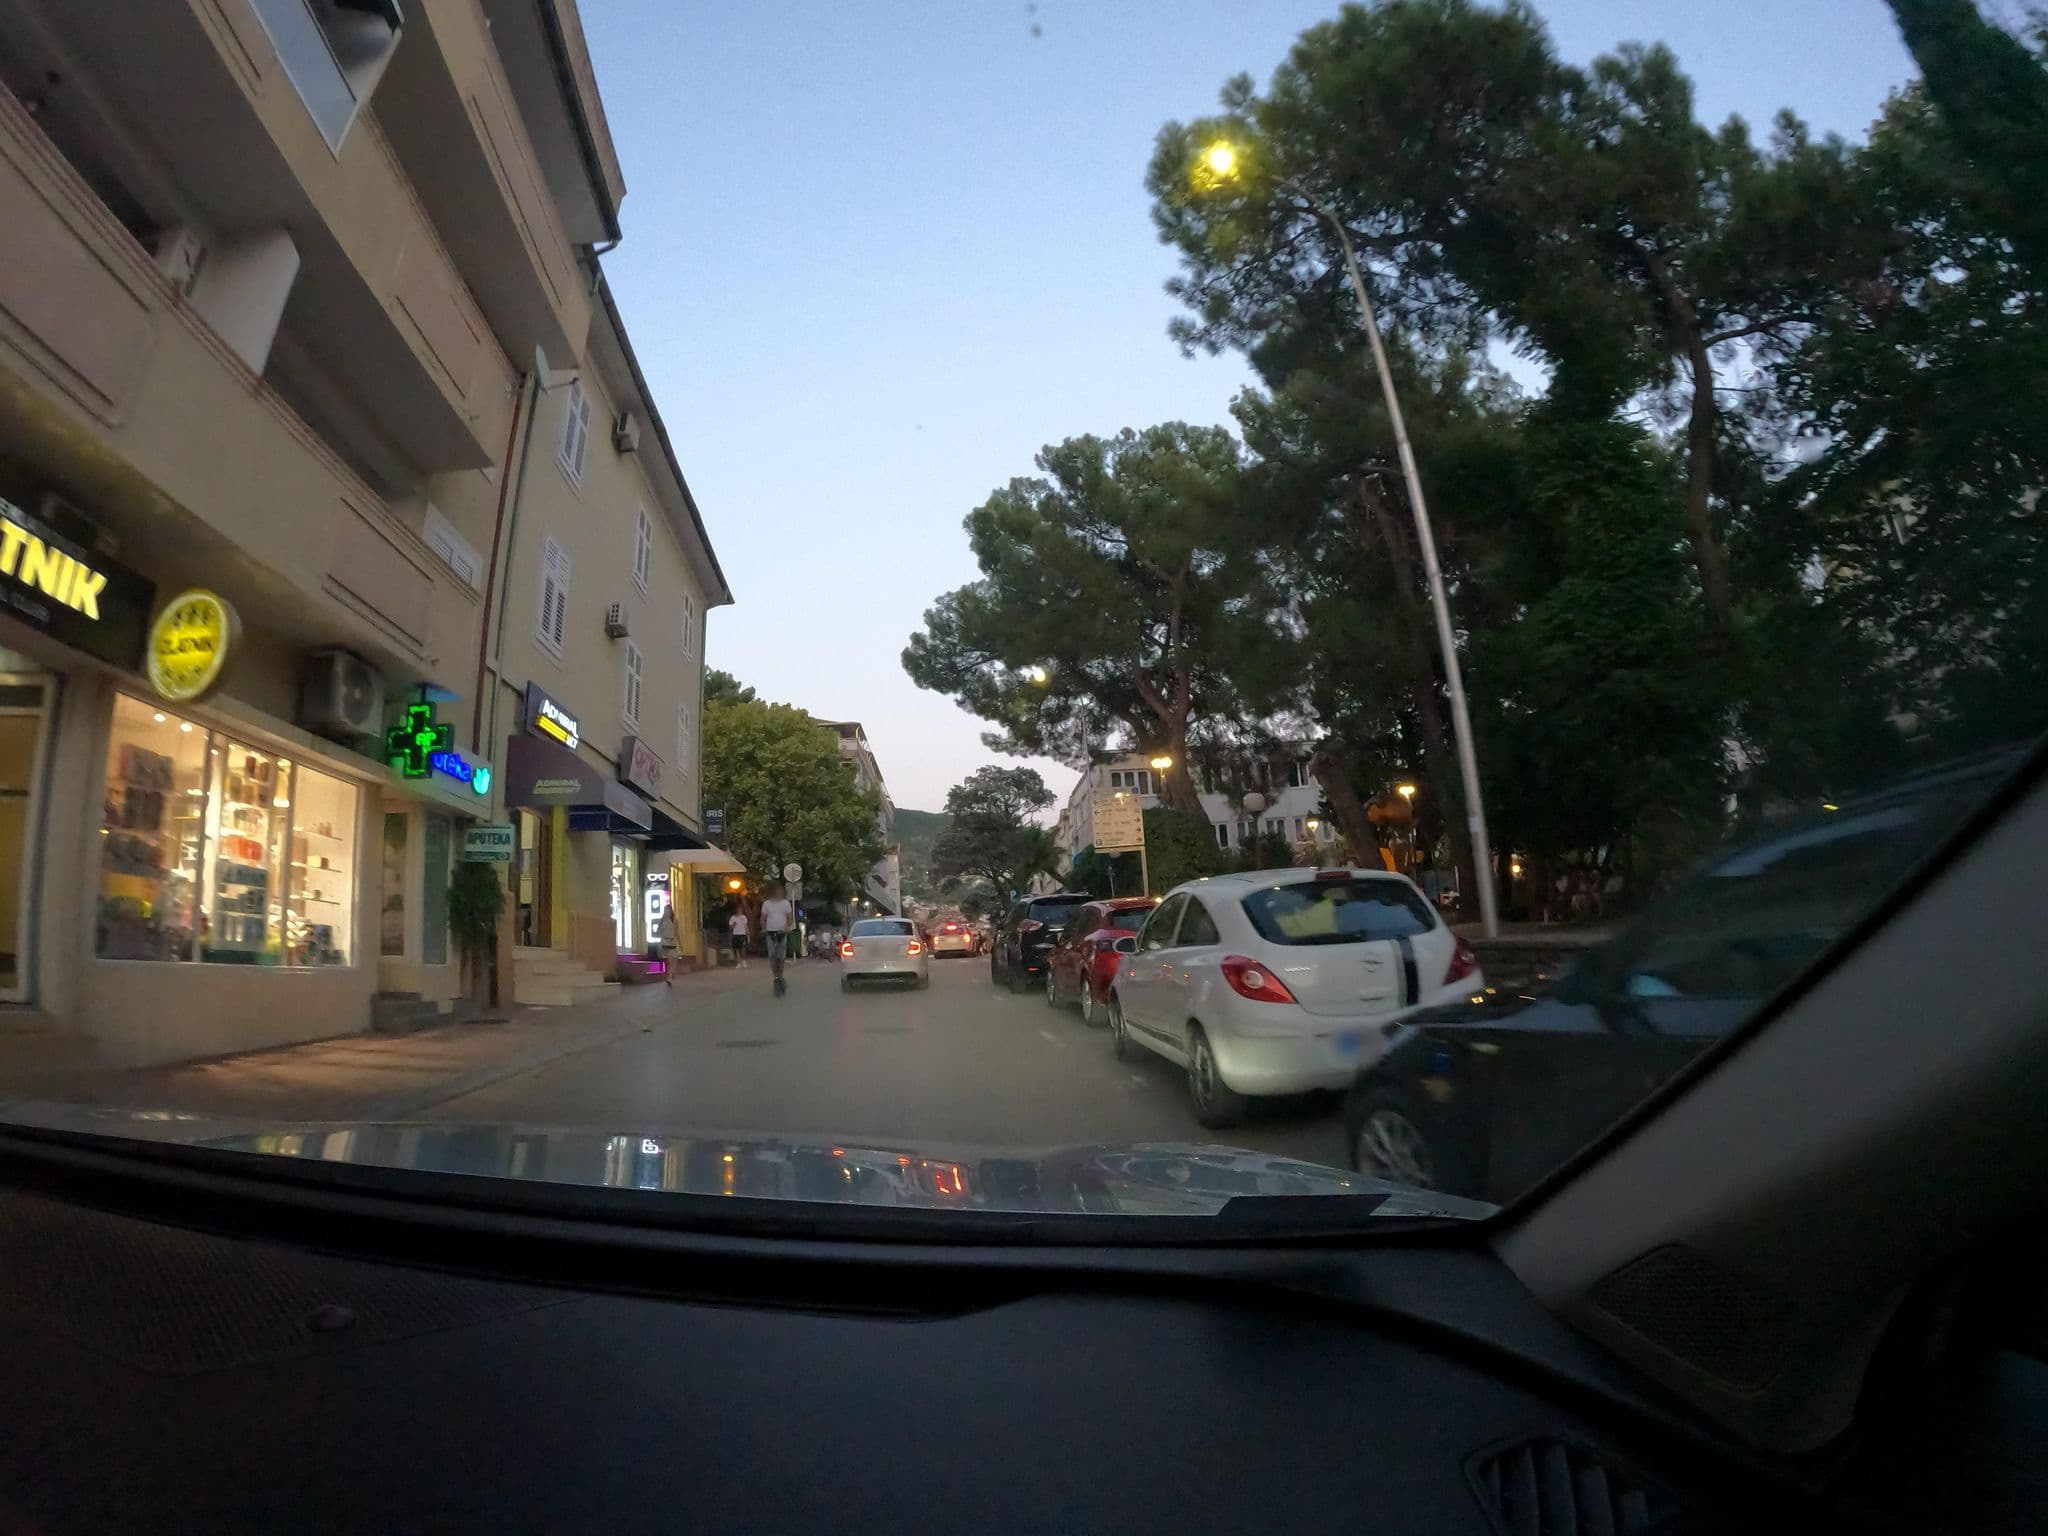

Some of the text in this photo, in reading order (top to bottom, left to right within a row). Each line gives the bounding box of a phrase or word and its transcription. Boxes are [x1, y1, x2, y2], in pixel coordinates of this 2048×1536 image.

[0, 516, 108, 620] TNIK
[542, 699, 579, 739] ADMIRAL
[706, 809, 724, 818] IRIS
